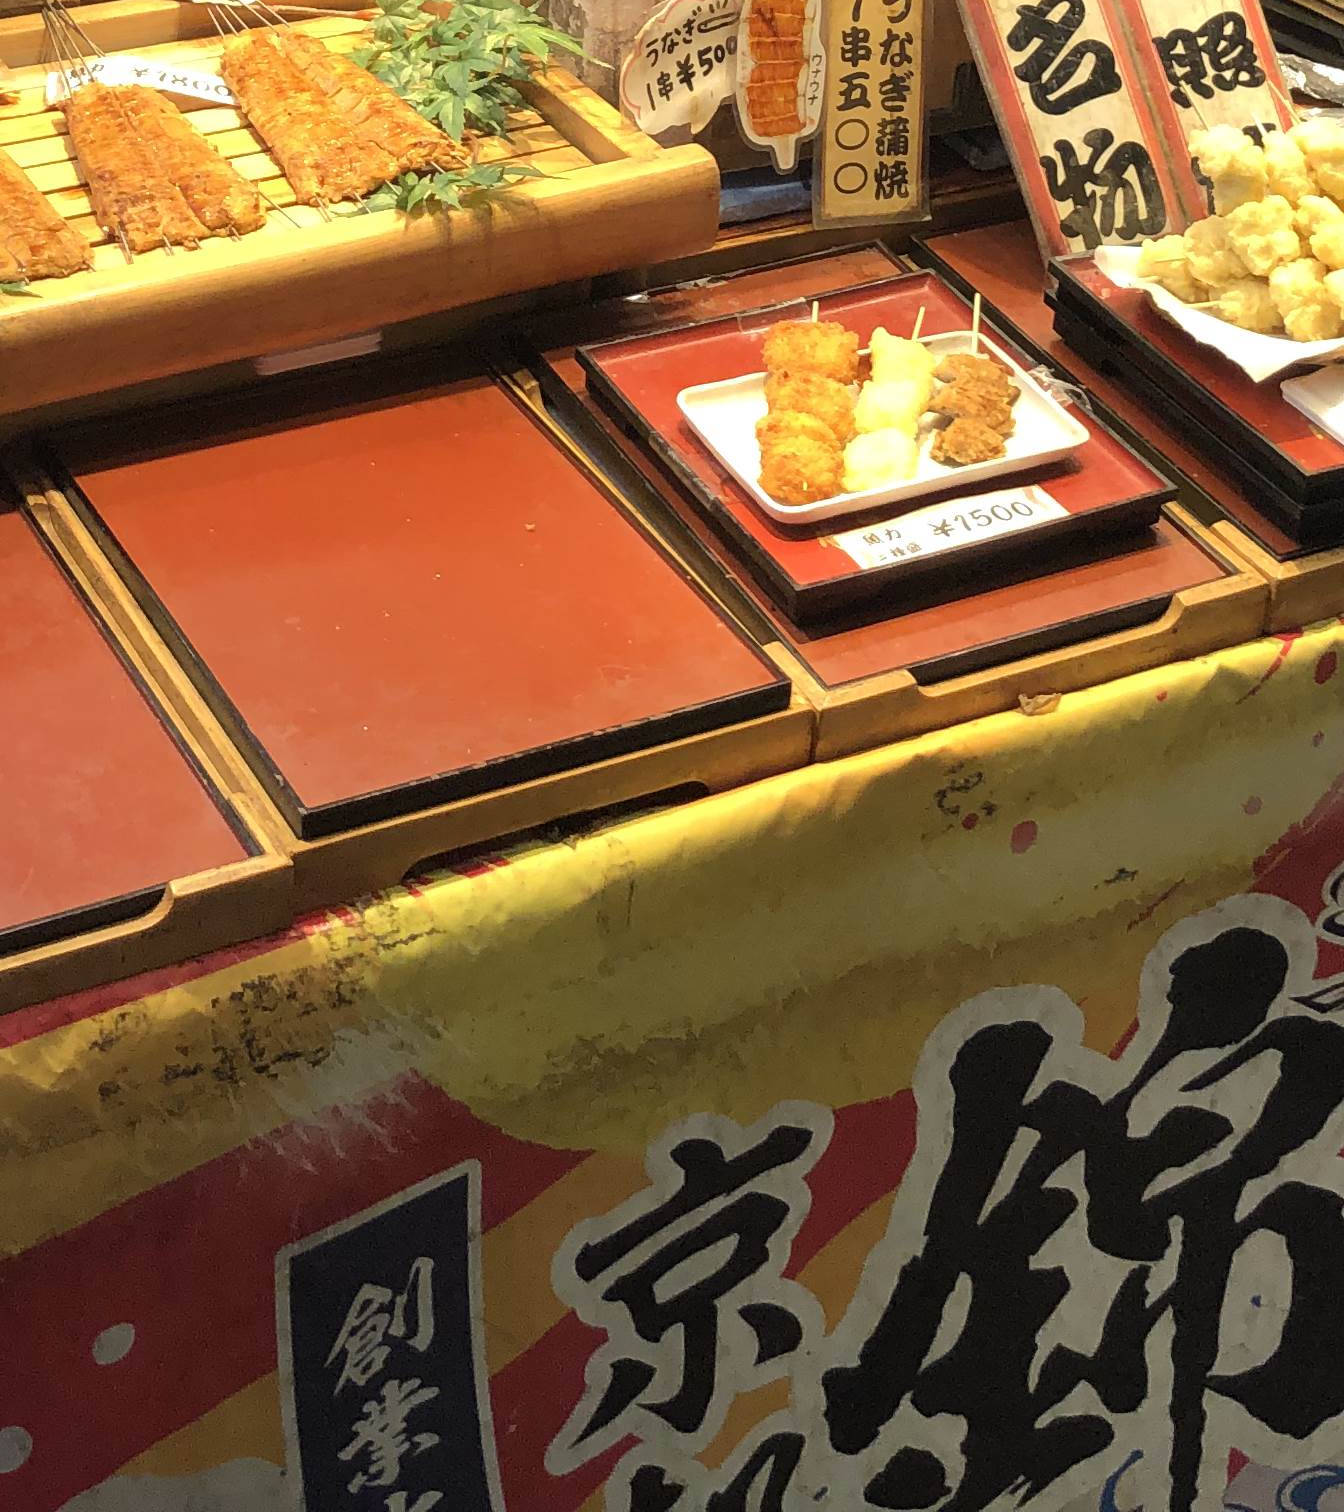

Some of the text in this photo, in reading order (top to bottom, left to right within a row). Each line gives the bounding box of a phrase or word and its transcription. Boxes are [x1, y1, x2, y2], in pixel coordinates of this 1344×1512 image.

[645, 5, 702, 68] うなぎ
[807, 53, 823, 106] ウナウナ
[928, 500, 1034, 538] ¥1500
[324, 1256, 444, 1512] 創業
